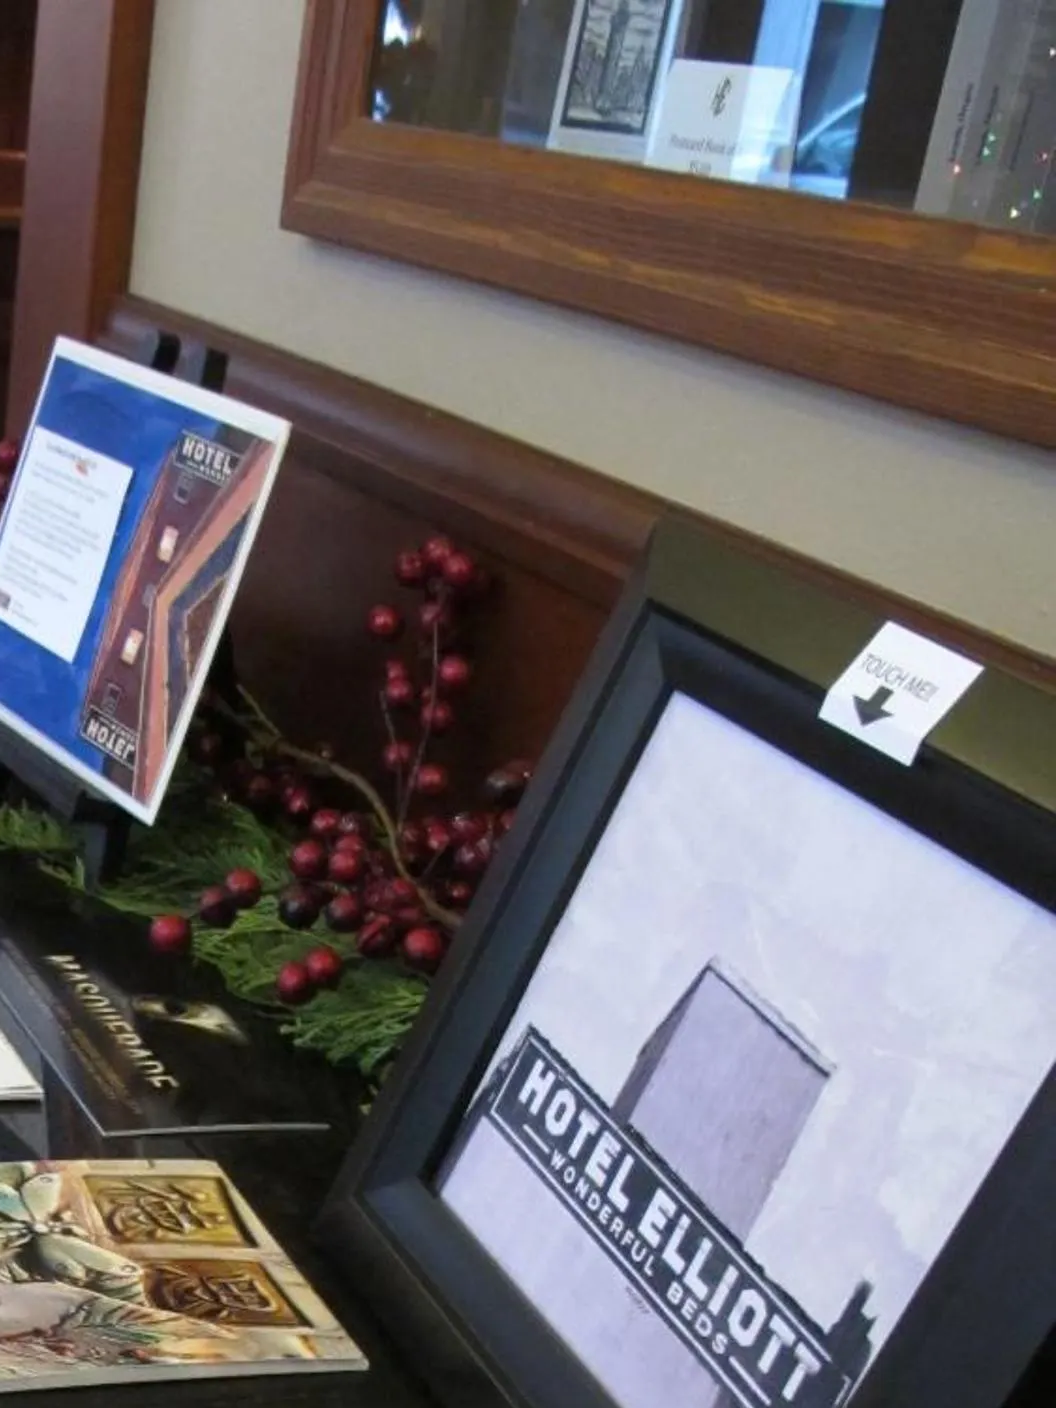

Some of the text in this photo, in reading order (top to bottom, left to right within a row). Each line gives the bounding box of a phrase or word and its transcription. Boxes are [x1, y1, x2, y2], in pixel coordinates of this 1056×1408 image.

[182, 435, 231, 475] HOTEL
[861, 652, 909, 687] TOUCH
[42, 954, 181, 1089] MASQUERADE
[517, 1057, 822, 1401] HOTEL ELLIOTT
[549, 1148, 730, 1356] WONDERFUL BEDS
